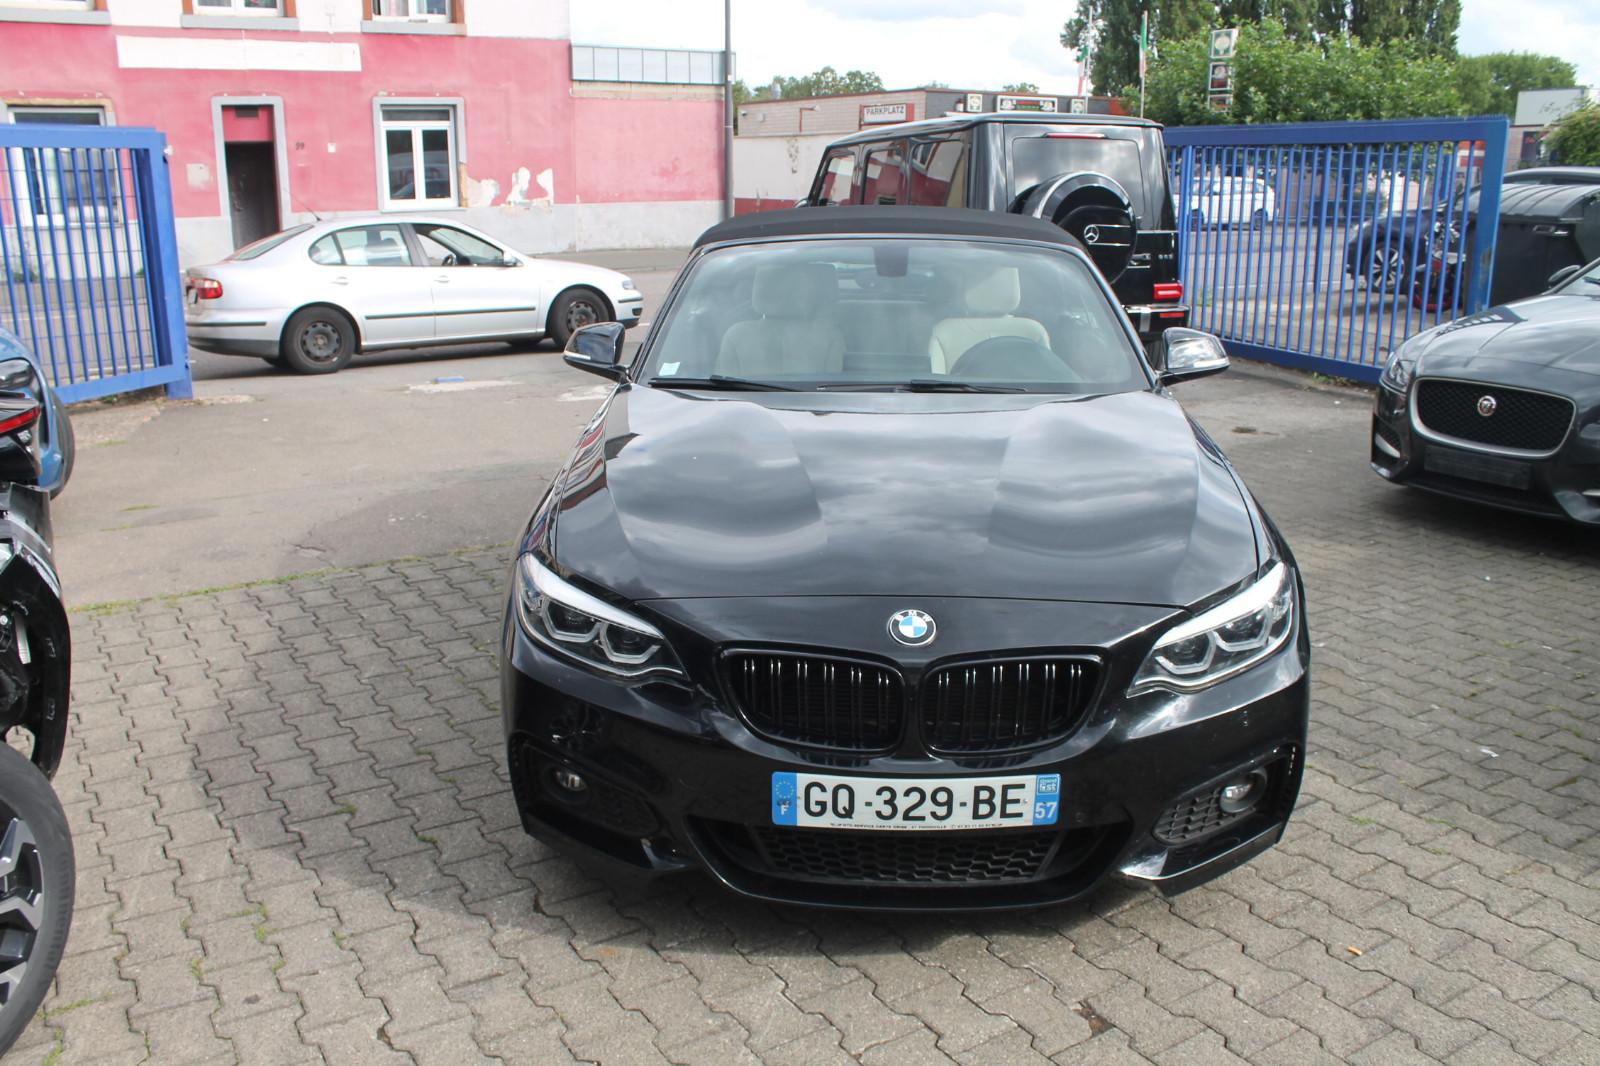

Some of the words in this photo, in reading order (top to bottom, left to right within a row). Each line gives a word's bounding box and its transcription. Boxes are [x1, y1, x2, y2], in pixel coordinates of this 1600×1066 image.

[865, 105, 904, 115] PARKPLATZ
[804, 780, 1027, 822] GQ-329-BE
[780, 804, 789, 815] F
[1034, 801, 1058, 819] 57
